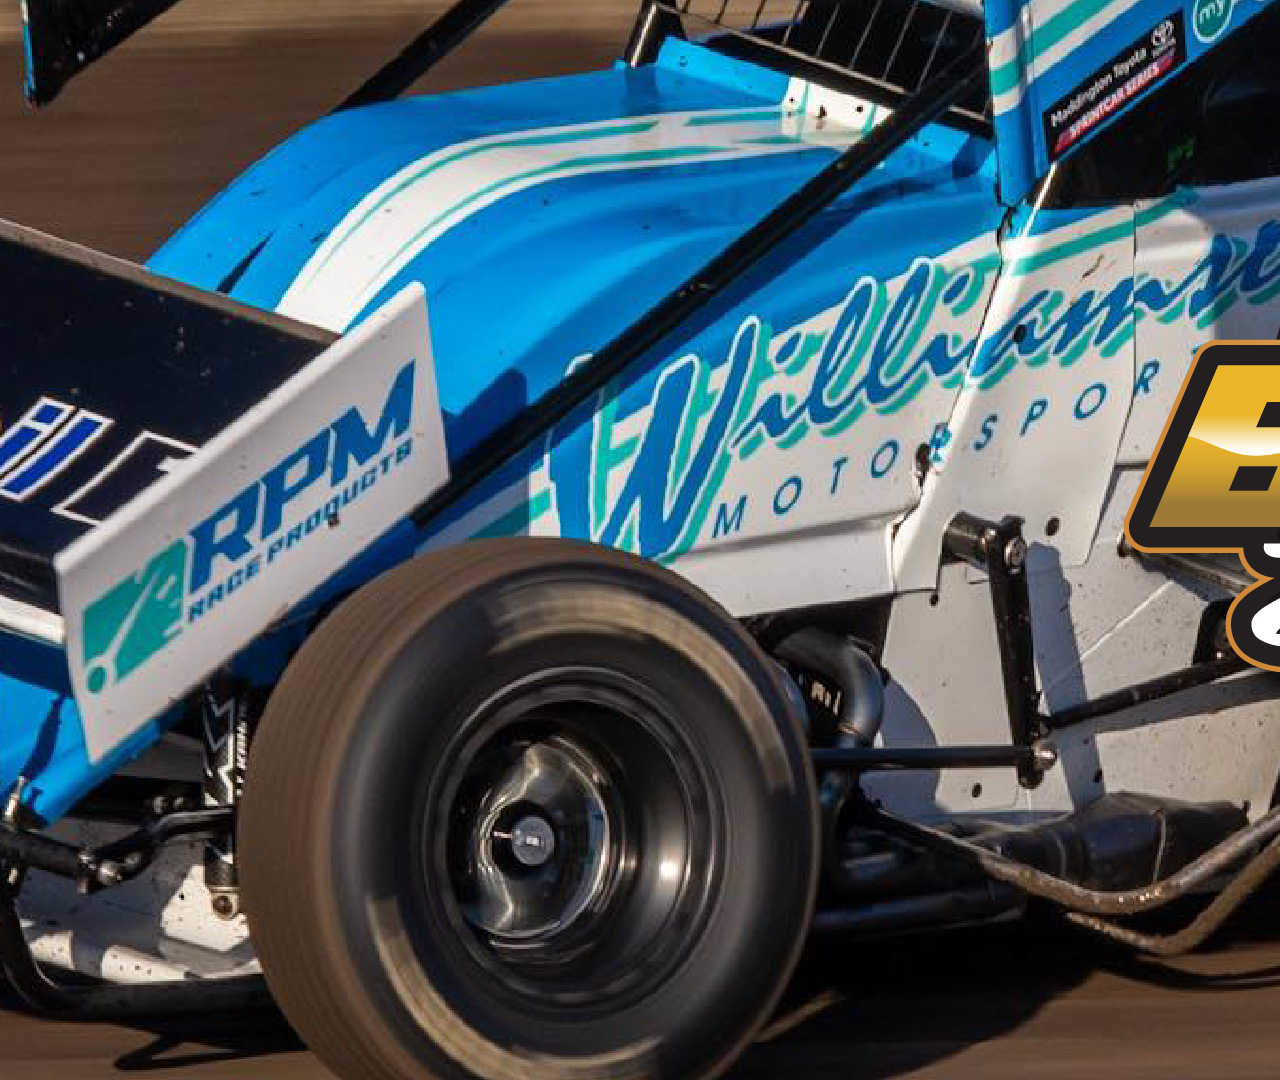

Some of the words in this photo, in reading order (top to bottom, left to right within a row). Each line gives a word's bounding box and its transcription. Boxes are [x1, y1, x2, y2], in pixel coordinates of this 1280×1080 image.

[186, 357, 417, 596] RPM
[187, 553, 261, 624] RACE
[266, 437, 413, 566] PRODUCTS
[712, 344, 1216, 542] MOTORSPOR
